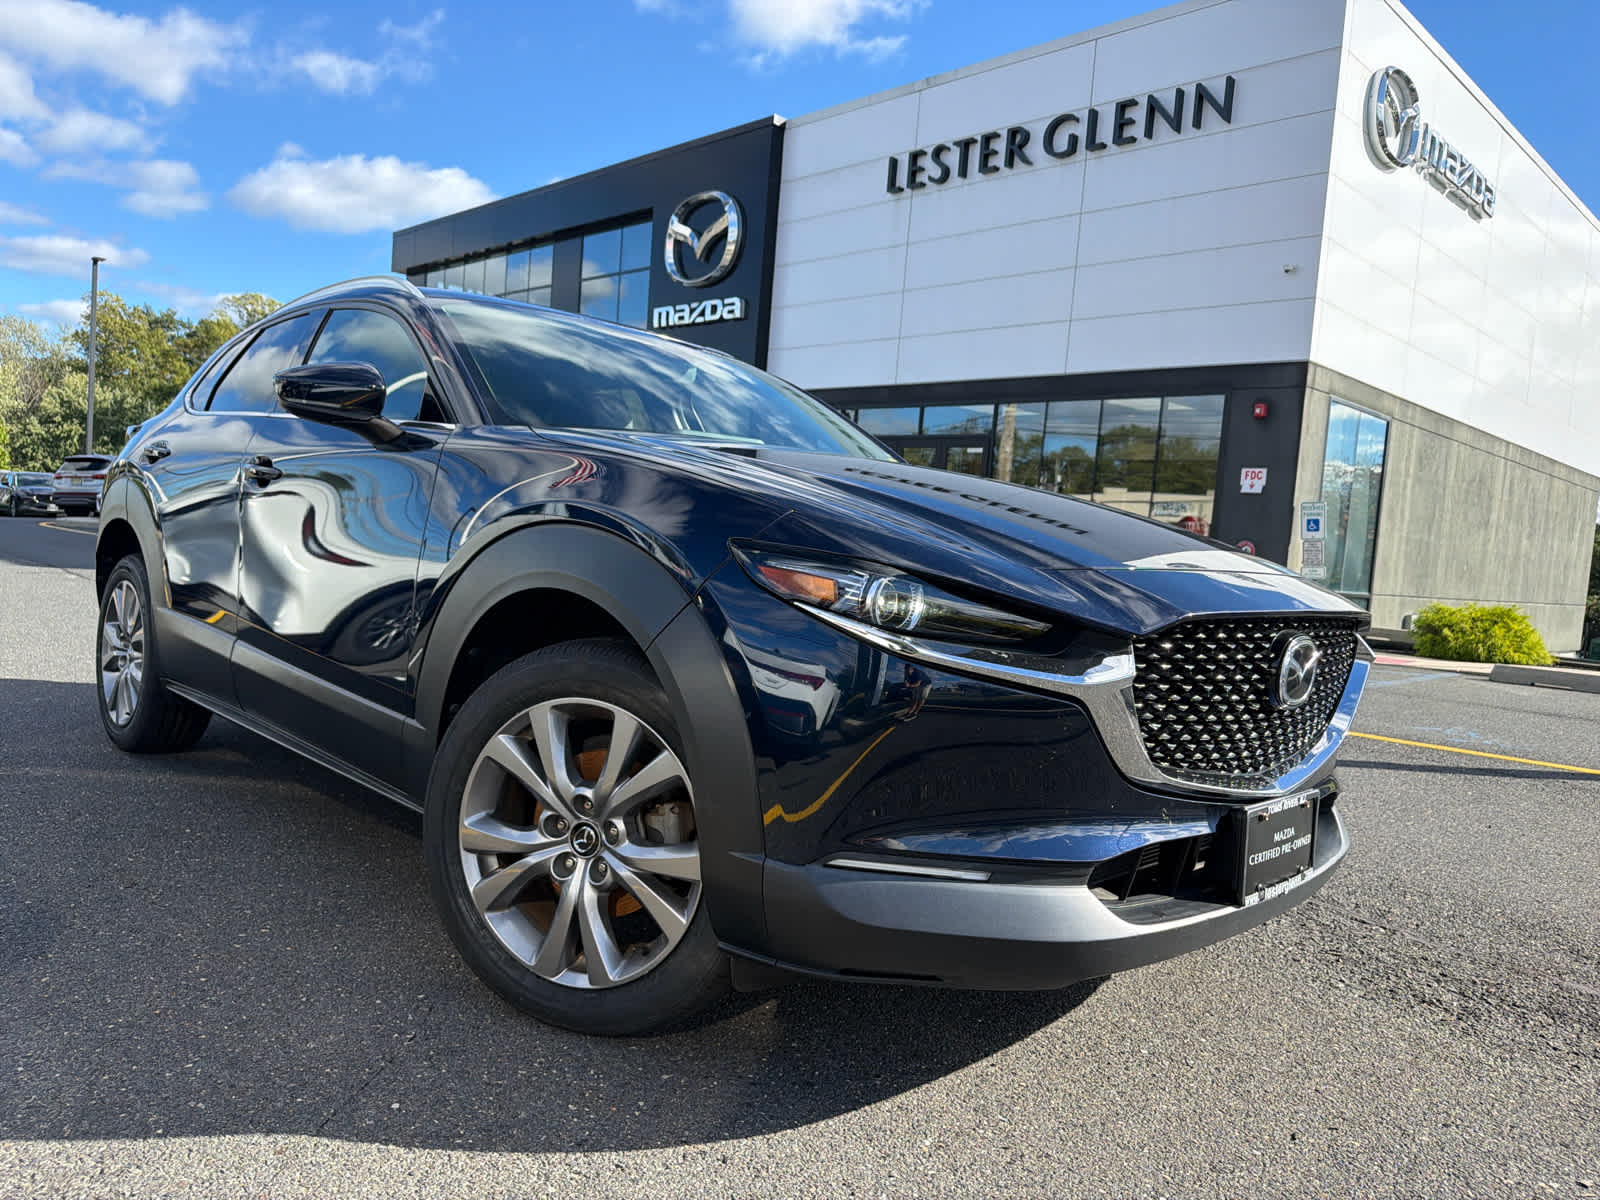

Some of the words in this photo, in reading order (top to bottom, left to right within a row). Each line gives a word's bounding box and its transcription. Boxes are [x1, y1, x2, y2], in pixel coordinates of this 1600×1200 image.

[886, 126, 1033, 194] LESTER
[1043, 75, 1236, 160] GLENN
[1244, 470, 1264, 481] FDC
[1273, 826, 1295, 842] MAZDA
[1249, 846, 1281, 865] CERTIFIED
